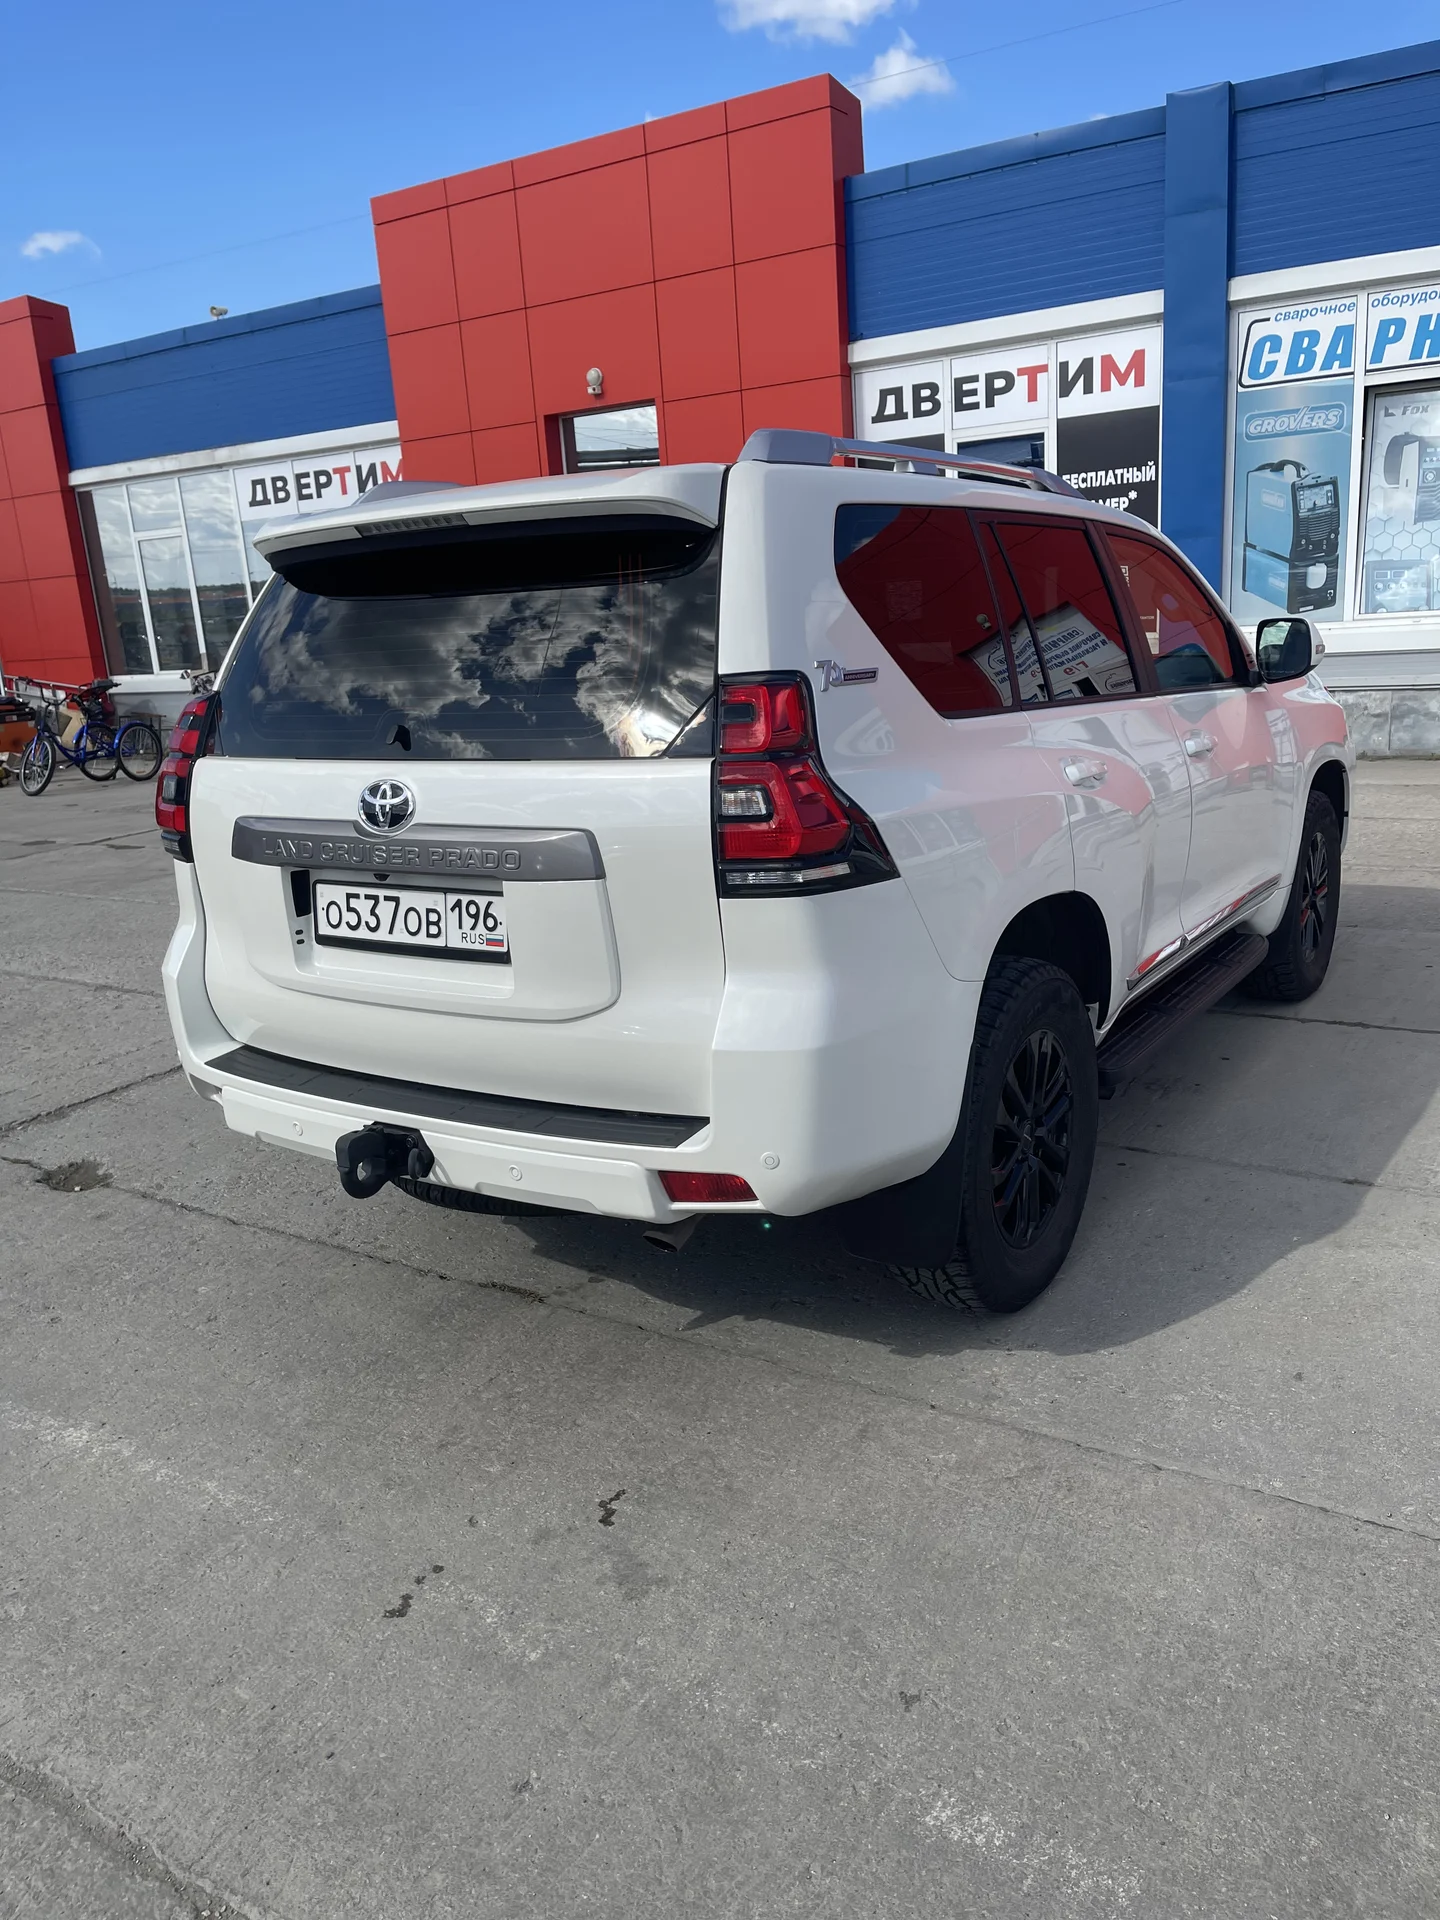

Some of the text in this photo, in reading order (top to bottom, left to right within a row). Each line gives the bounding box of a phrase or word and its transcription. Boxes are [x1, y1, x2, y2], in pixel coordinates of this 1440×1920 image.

[1274, 290, 1440, 322] сварочное оборудо
[871, 348, 1146, 424] ДВЕРТИМ
[1247, 406, 1342, 436] GROVERS
[262, 837, 521, 872] LAND CRUISER PRADO
[450, 898, 498, 933] 196
[462, 932, 485, 945] RUS
